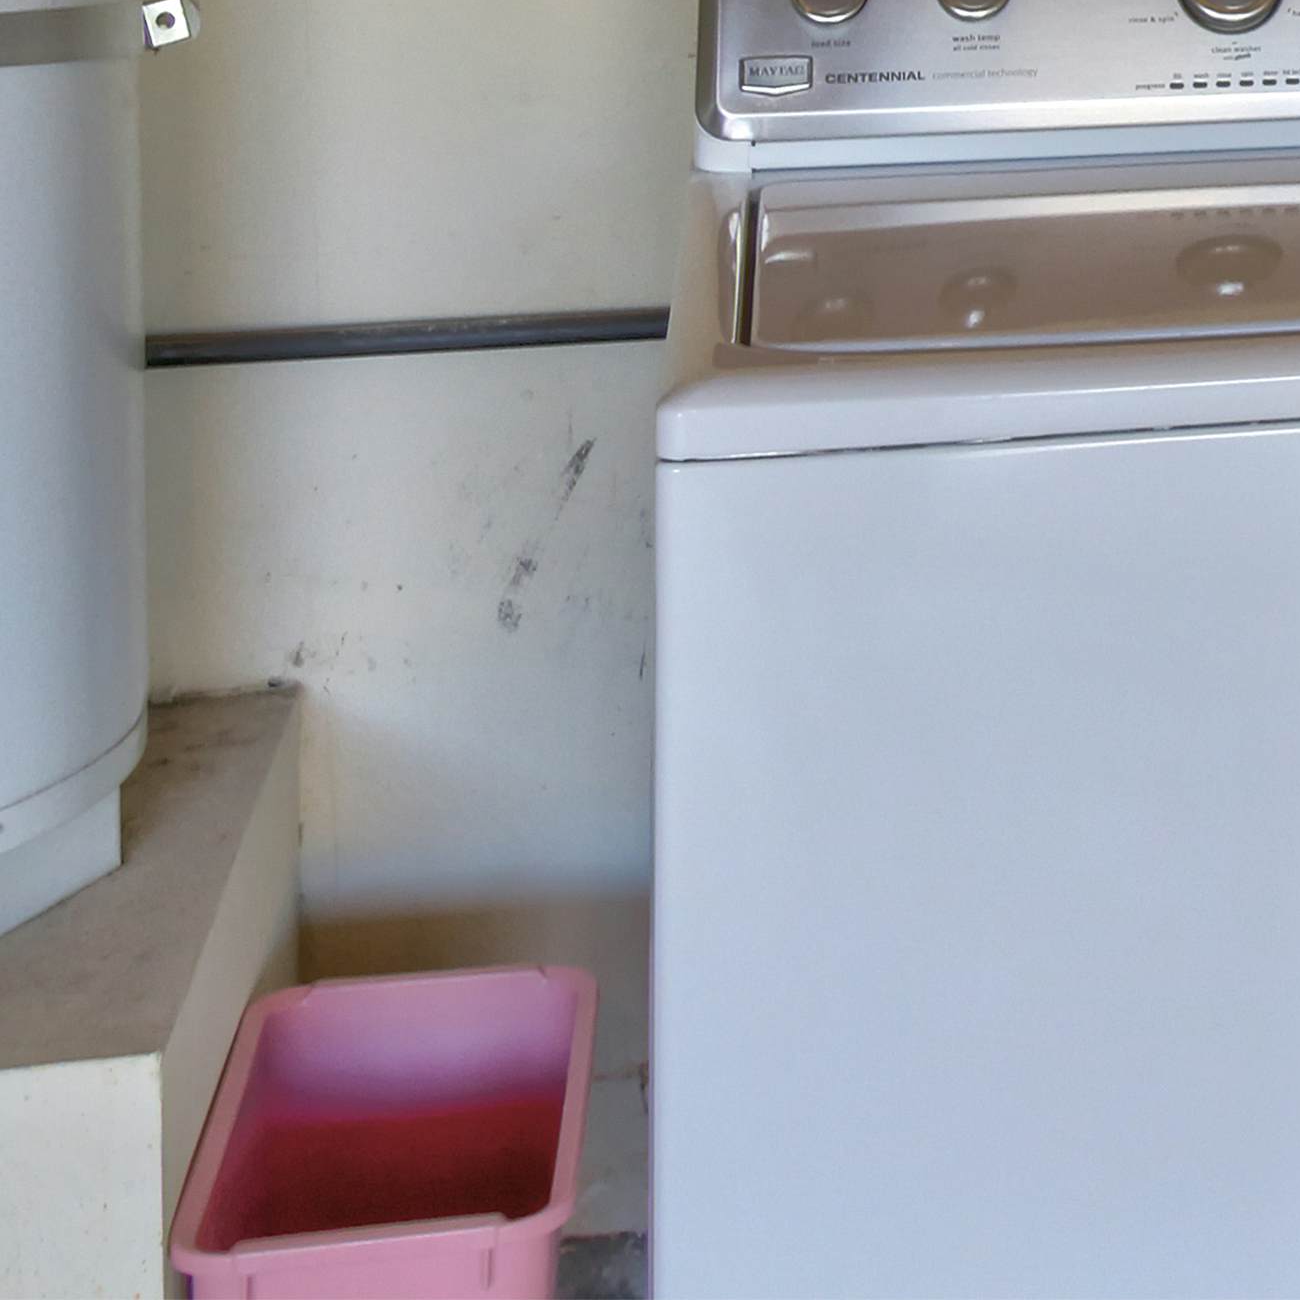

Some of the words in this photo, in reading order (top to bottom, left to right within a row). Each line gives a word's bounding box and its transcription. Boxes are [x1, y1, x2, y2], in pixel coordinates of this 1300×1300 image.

[1158, 16, 1175, 24] spin
[811, 39, 831, 48] load
[833, 38, 851, 48] size
[952, 33, 976, 43] wash
[977, 34, 1001, 44] temp
[1211, 46, 1232, 54] clean
[748, 65, 805, 78] MAYTAG
[825, 70, 926, 85] CENTENNIAL
[932, 68, 986, 81] commercial
[987, 67, 1039, 81] technology
[1135, 83, 1166, 91] progress
